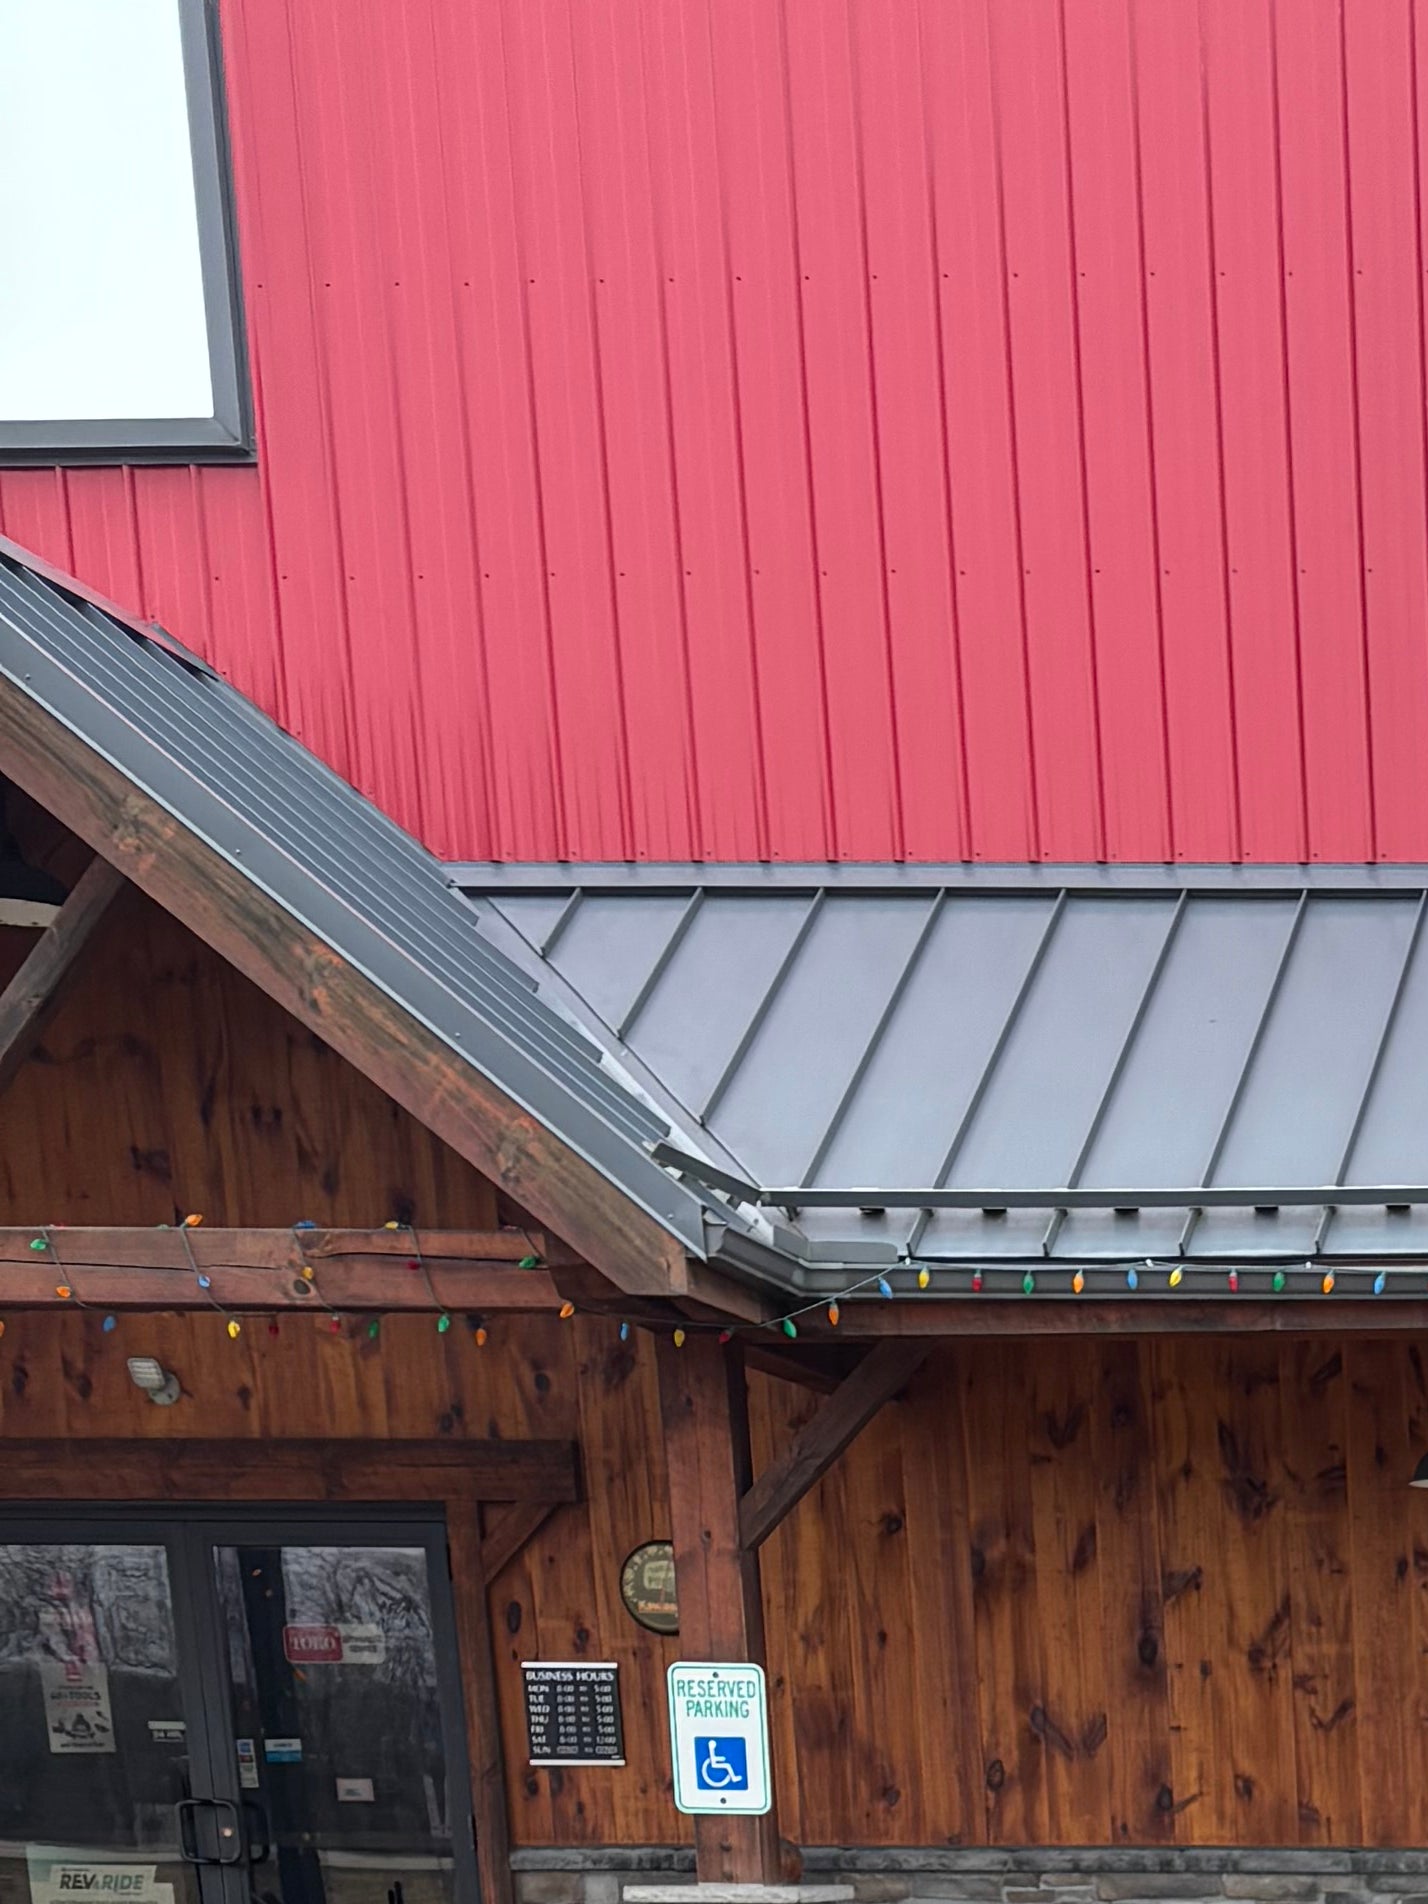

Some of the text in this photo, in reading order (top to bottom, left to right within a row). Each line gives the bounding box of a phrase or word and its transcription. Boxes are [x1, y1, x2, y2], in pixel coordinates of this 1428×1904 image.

[526, 1671, 615, 1681] BUSINESS HOURS
[676, 1680, 757, 1698] RESERVED
[686, 1700, 751, 1718] PARKING
